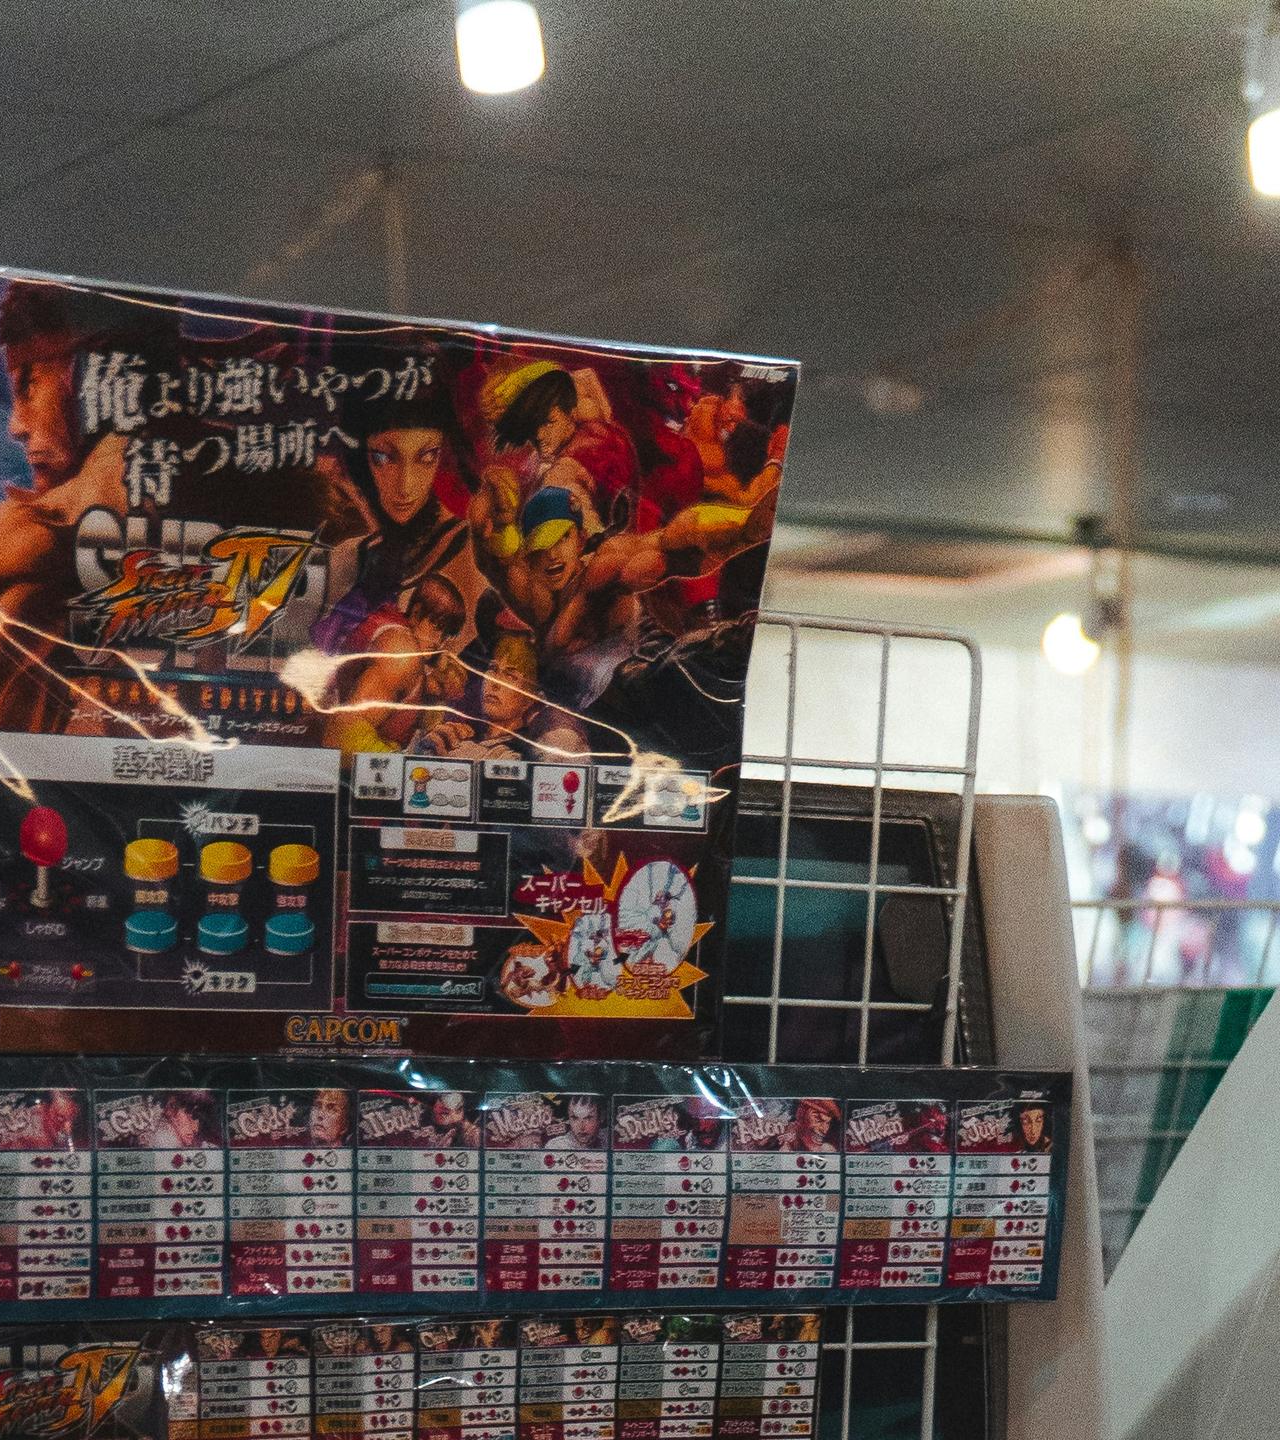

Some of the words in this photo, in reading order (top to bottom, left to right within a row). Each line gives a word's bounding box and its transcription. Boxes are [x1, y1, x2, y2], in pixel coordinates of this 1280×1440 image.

[79, 351, 436, 434] 俺より強いやつが
[126, 421, 360, 507] 待つ場所へ
[112, 745, 214, 783] 基本操作
[520, 873, 581, 893] スーパー
[535, 895, 608, 915] キャンセル
[287, 1016, 402, 1046] CAPCOM
